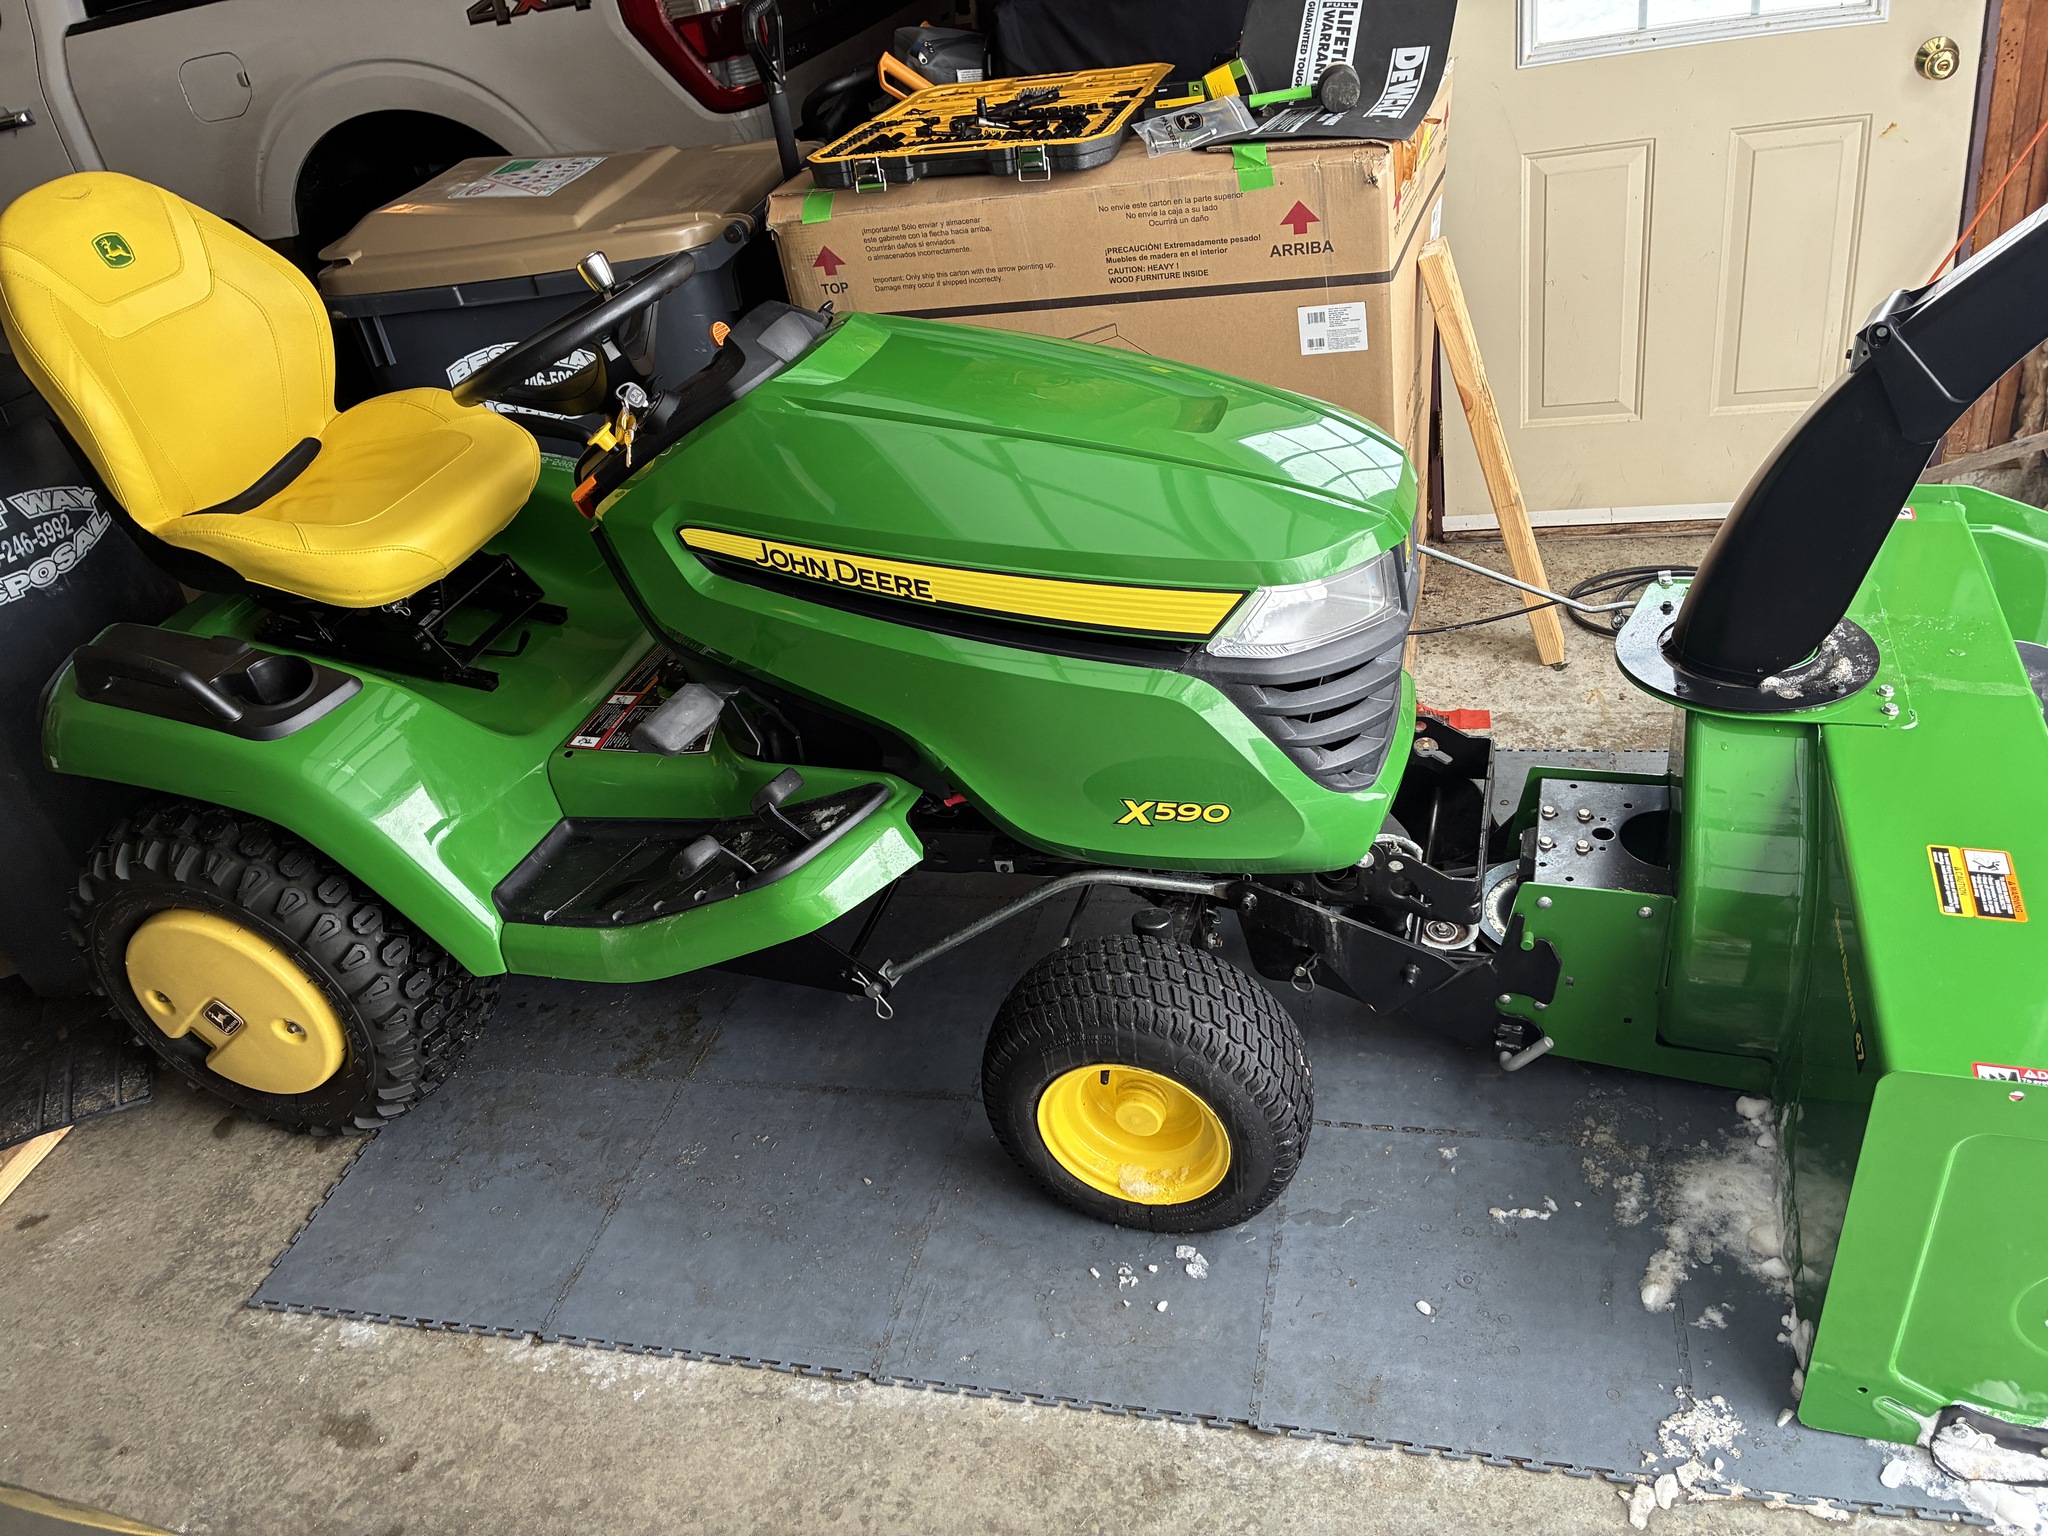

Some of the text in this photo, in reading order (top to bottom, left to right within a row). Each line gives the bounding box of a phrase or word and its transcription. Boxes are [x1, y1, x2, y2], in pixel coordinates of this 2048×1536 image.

[1301, 1, 1316, 55] GUARANTEED
[1331, 10, 1354, 63] LIFETI
[1313, 9, 1336, 82] WARRAN
[1368, 47, 1427, 118] DEWALT
[1149, 199, 1172, 207] cartón
[1193, 195, 1212, 204] parte
[1214, 192, 1244, 201] superior
[1168, 208, 1183, 216] caja
[901, 223, 917, 231] Sólo
[918, 221, 938, 229] enviar
[946, 218, 980, 226] almacenar
[1148, 217, 1178, 226] Ocurrirá
[865, 244, 896, 252] Ocurrirán
[897, 242, 917, 250] daños
[926, 238, 955, 247] enviados
[878, 233, 907, 244] gabinete
[908, 232, 920, 240] con
[1105, 234, 1261, 256] ¡PRECAUCIÓN! Extremadamente pesado!
[874, 251, 916, 261] almacenados
[917, 246, 972, 257] incorrectamente.
[1106, 255, 1137, 264] Muebles
[1150, 252, 1178, 260] madera
[1200, 247, 1228, 255] interior
[1270, 240, 1334, 258] ARRIBA
[872, 275, 904, 284] Important:
[1017, 263, 1043, 271] pointing
[1108, 266, 1146, 275] CAUTION:
[1148, 263, 1174, 271] HEAVY
[1109, 269, 1209, 284] WOOD FURNITURE INSIDE
[820, 282, 848, 295] TOP
[942, 278, 967, 286] shipped
[969, 275, 1003, 284] incorrectly.
[9, 487, 97, 518] WAY
[0, 514, 74, 566] -246-5992
[756, 542, 934, 600] JOHN DEERE
[1113, 798, 1232, 827] X590
[1956, 872, 1968, 896] CAUTION
[2011, 886, 2023, 913] WARNING
